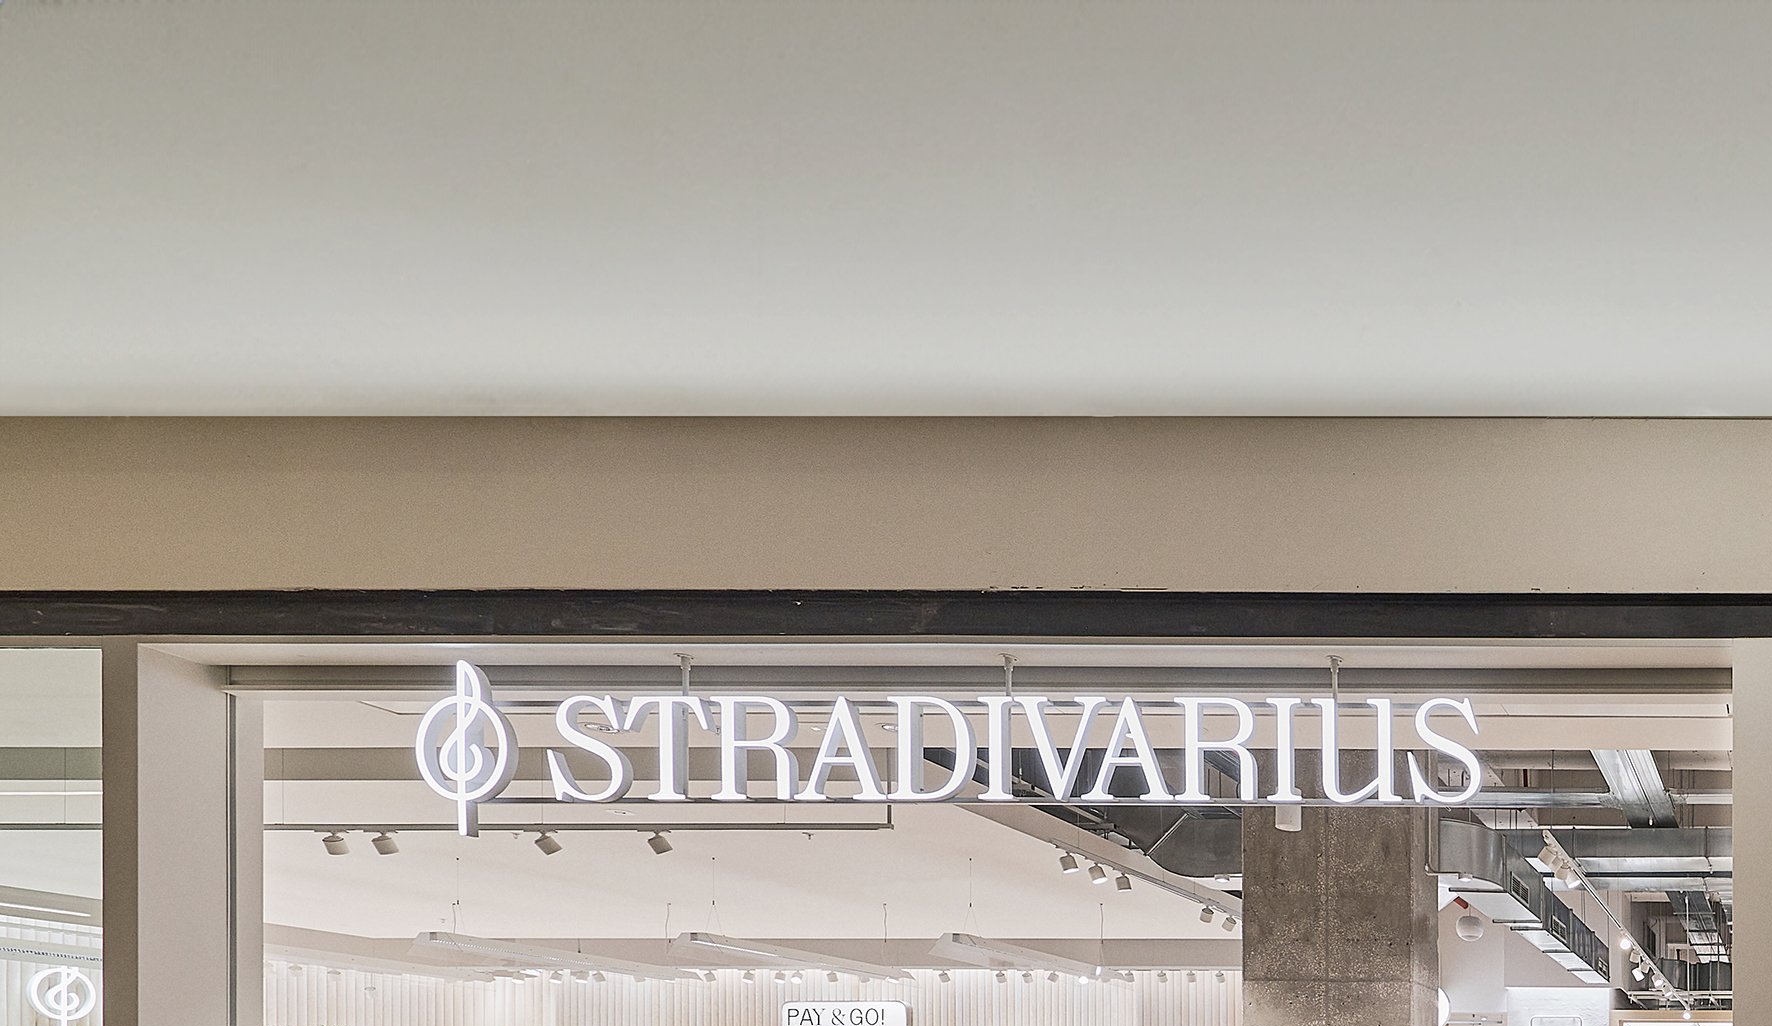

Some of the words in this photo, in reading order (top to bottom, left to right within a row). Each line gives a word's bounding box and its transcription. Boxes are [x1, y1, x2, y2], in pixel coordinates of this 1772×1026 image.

[546, 695, 1482, 804] STRADIVARIUS
[787, 1008, 826, 1026] PAY
[831, 1008, 846, 1026] &
[849, 1008, 885, 1026] GO!
